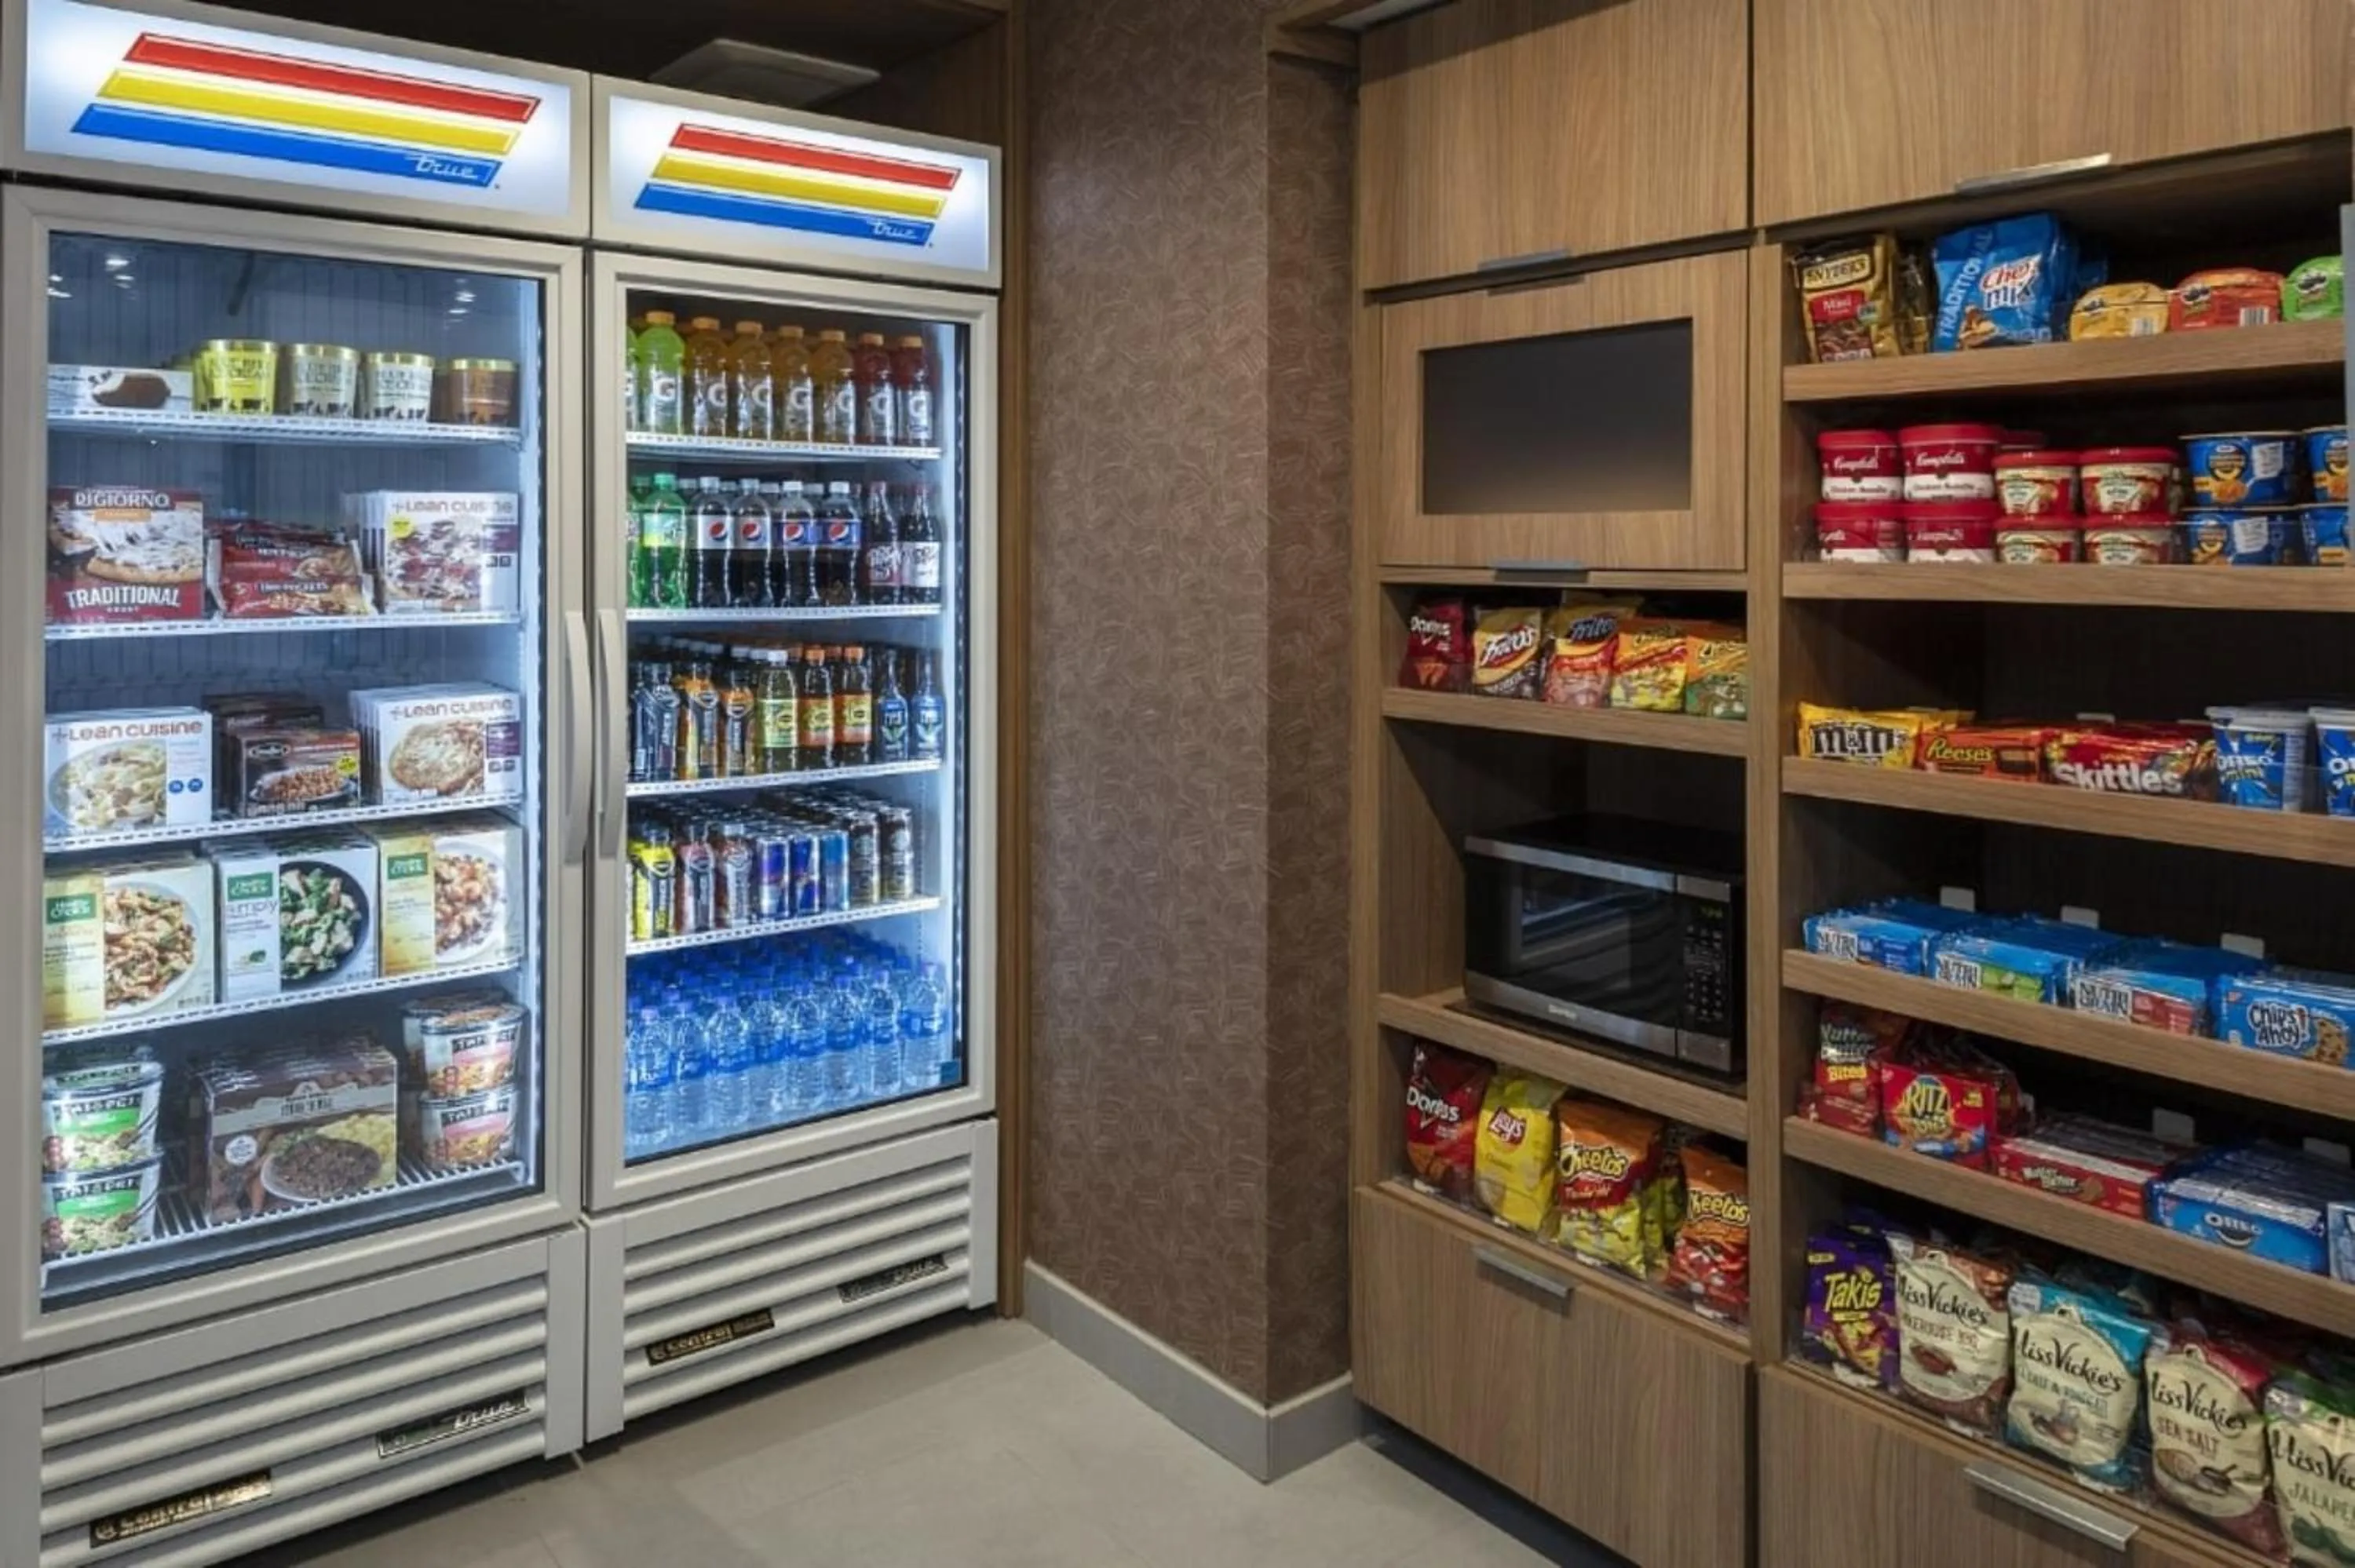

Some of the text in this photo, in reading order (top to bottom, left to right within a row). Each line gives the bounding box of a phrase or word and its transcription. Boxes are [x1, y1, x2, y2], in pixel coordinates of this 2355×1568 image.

[64, 585, 182, 609] TRADITIONAL
[2250, 1002, 2298, 1030] Chips
[1406, 1085, 1461, 1123] Doritos
[1907, 1081, 1948, 1117] RITZ
[1559, 1145, 1625, 1176] Cheetos
[1689, 1191, 1750, 1222] heetos
[1824, 1271, 1882, 1313] Takis
